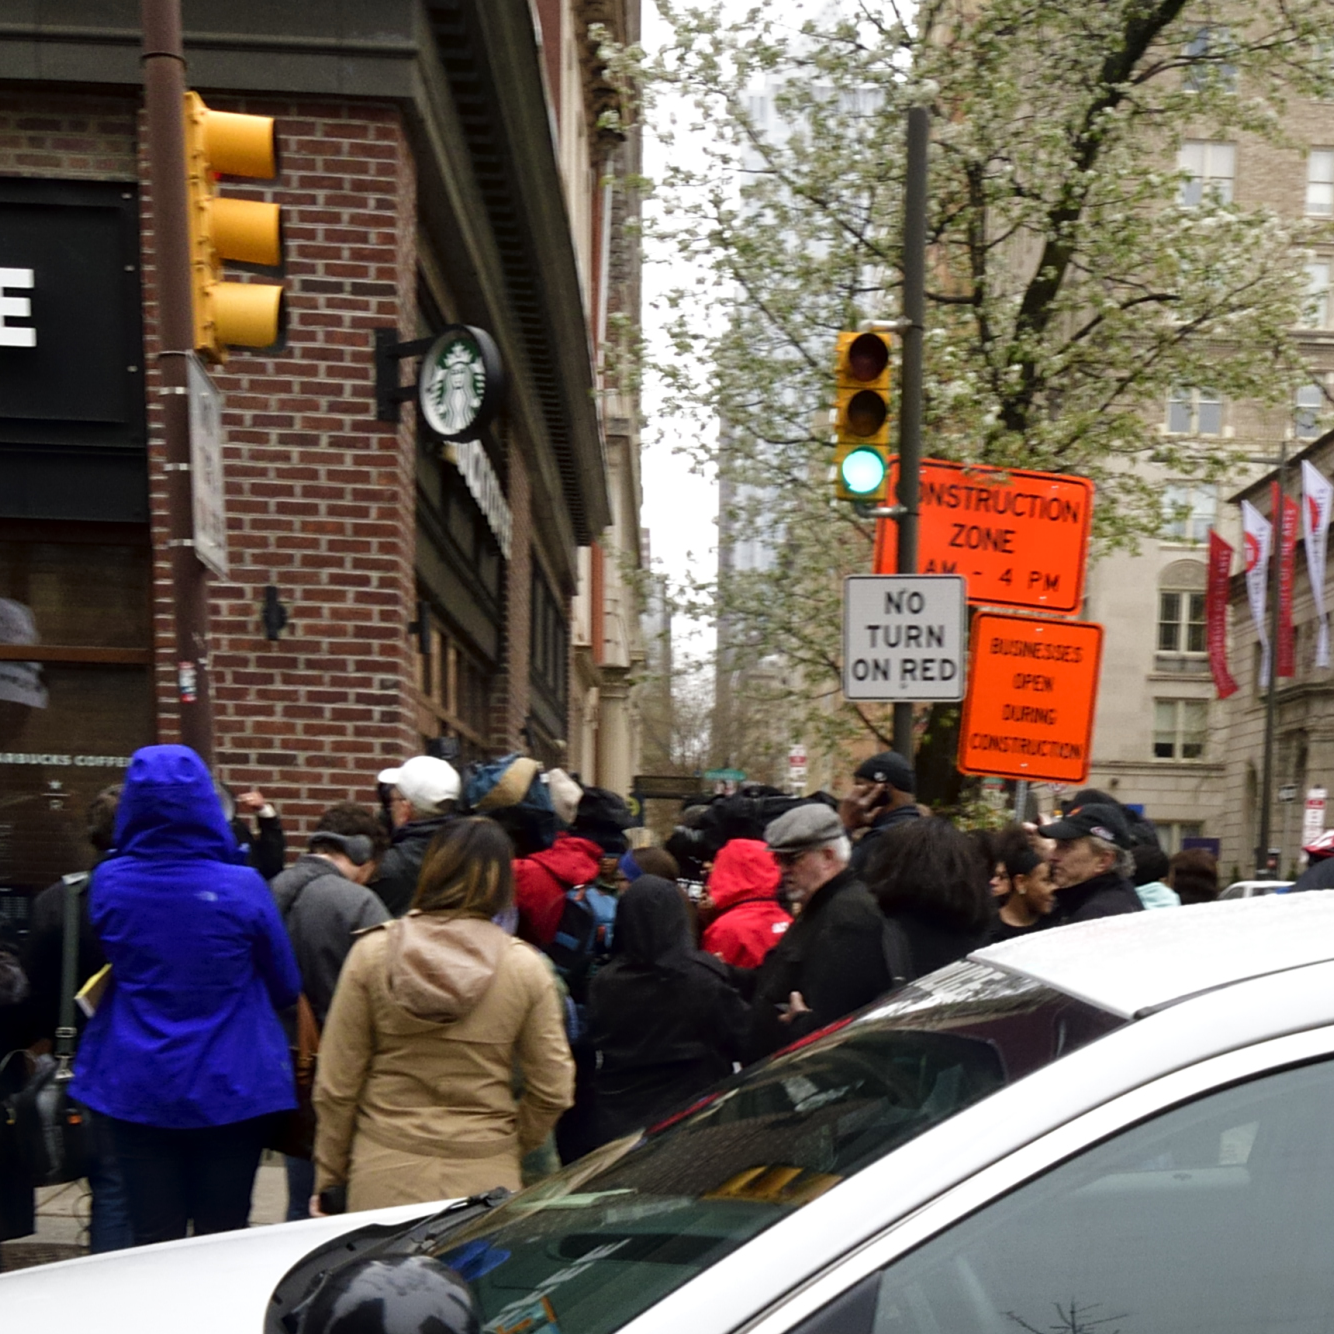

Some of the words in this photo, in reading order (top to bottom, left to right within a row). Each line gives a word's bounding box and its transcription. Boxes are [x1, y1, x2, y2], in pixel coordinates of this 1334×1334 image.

[918, 481, 1080, 524] ONSTRUCTION
[1282, 508, 1297, 537] ARTS
[949, 523, 1015, 554] ZONE
[998, 568, 1013, 586] 4
[1028, 571, 1060, 593] PM
[884, 592, 925, 615] NO
[867, 625, 945, 648] TURN
[991, 637, 1083, 663] BUSINESSES
[852, 659, 890, 681] ON
[901, 659, 957, 681] RED
[1013, 673, 1054, 692] OPEN
[1002, 703, 1057, 726] DURING
[969, 732, 1082, 760] CONSTRUCTION
